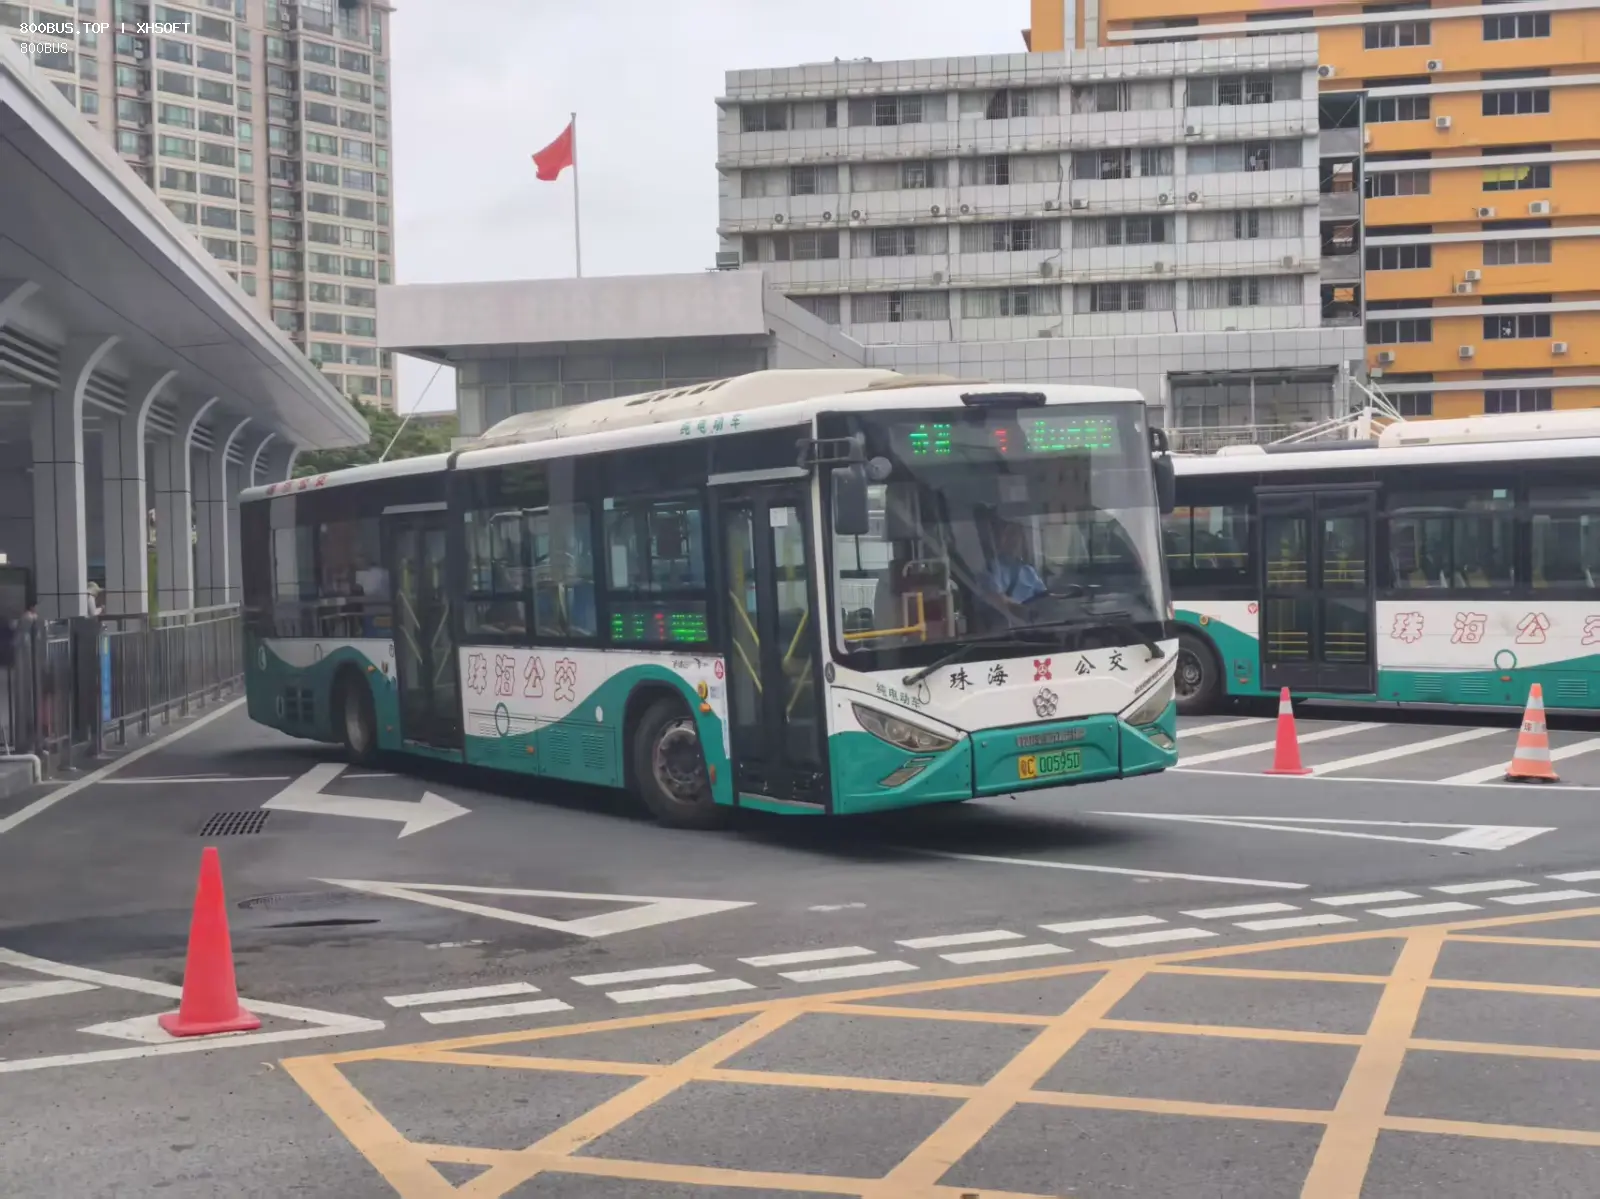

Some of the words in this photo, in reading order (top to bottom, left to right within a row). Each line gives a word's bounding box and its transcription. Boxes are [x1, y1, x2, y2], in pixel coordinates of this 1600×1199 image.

[467, 652, 577, 702] 珠海公交
[949, 663, 1009, 691] 珠海
[1074, 650, 1128, 676] 公交
